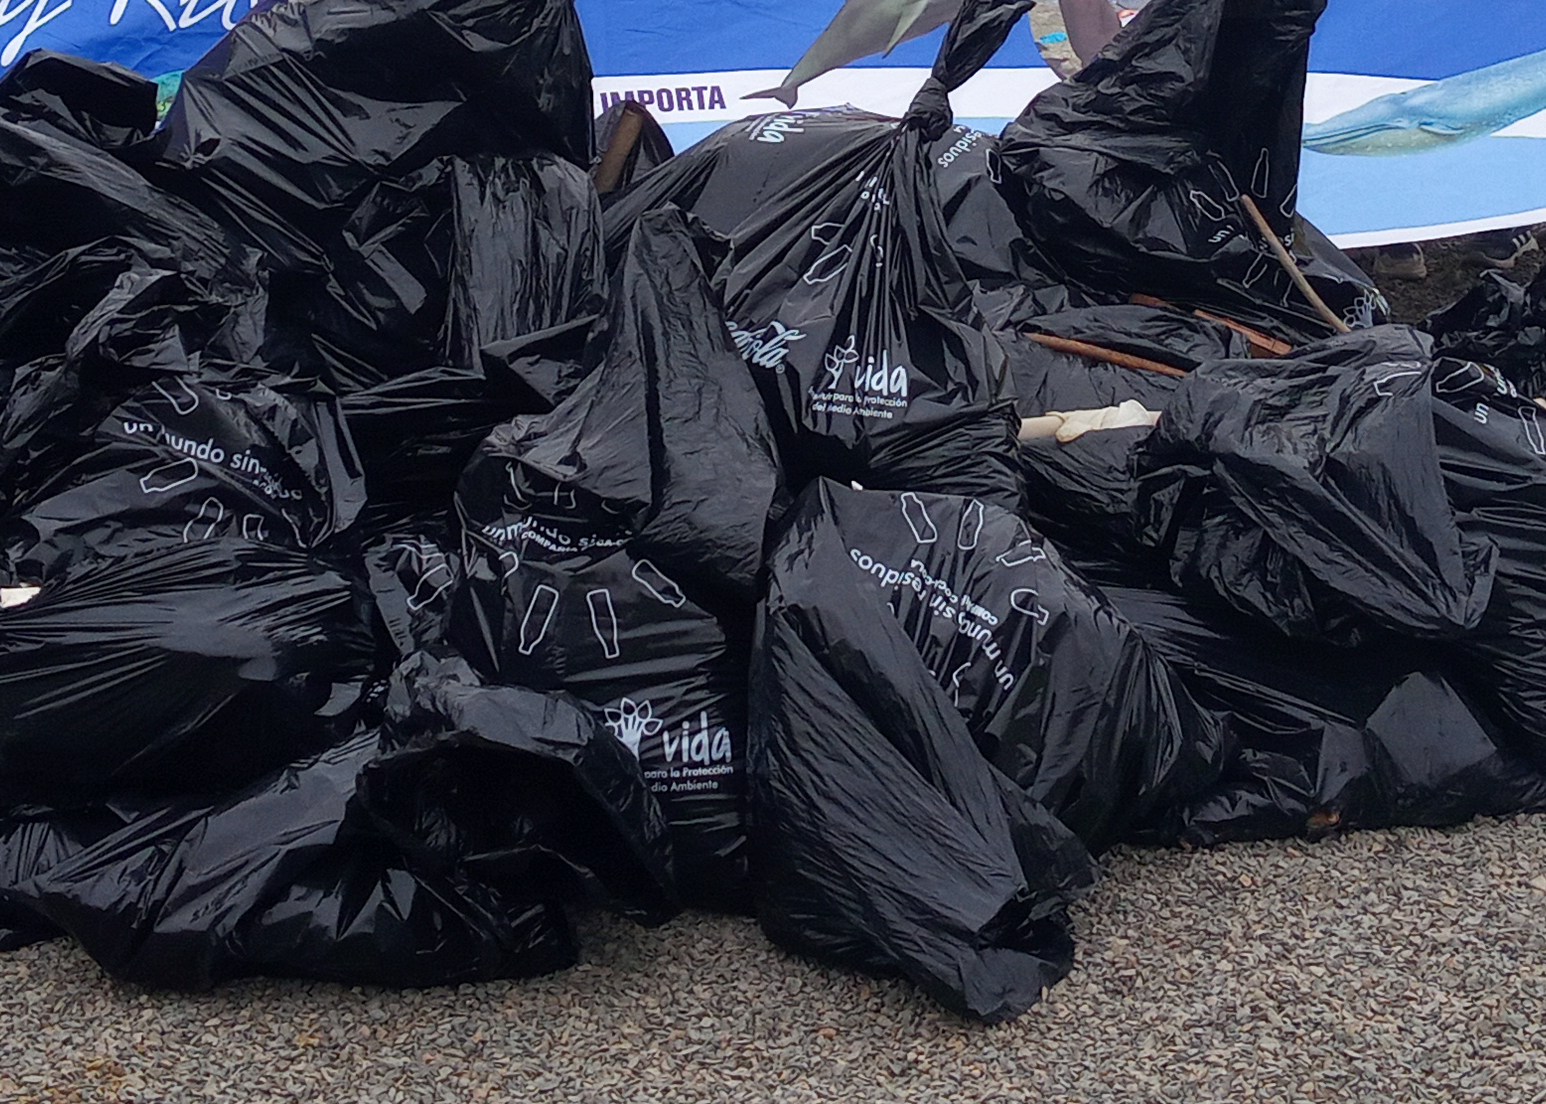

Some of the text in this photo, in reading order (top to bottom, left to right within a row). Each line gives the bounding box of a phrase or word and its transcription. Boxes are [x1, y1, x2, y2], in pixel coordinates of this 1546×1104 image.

[599, 85, 727, 113] IMPORTA
[937, 129, 983, 169] esiduos
[855, 349, 908, 397] vida
[229, 450, 260, 476] sin
[662, 711, 732, 766] vida
[669, 766, 680, 777] la
[681, 764, 734, 777] Protección
[651, 780, 718, 793] dio Ambiente
